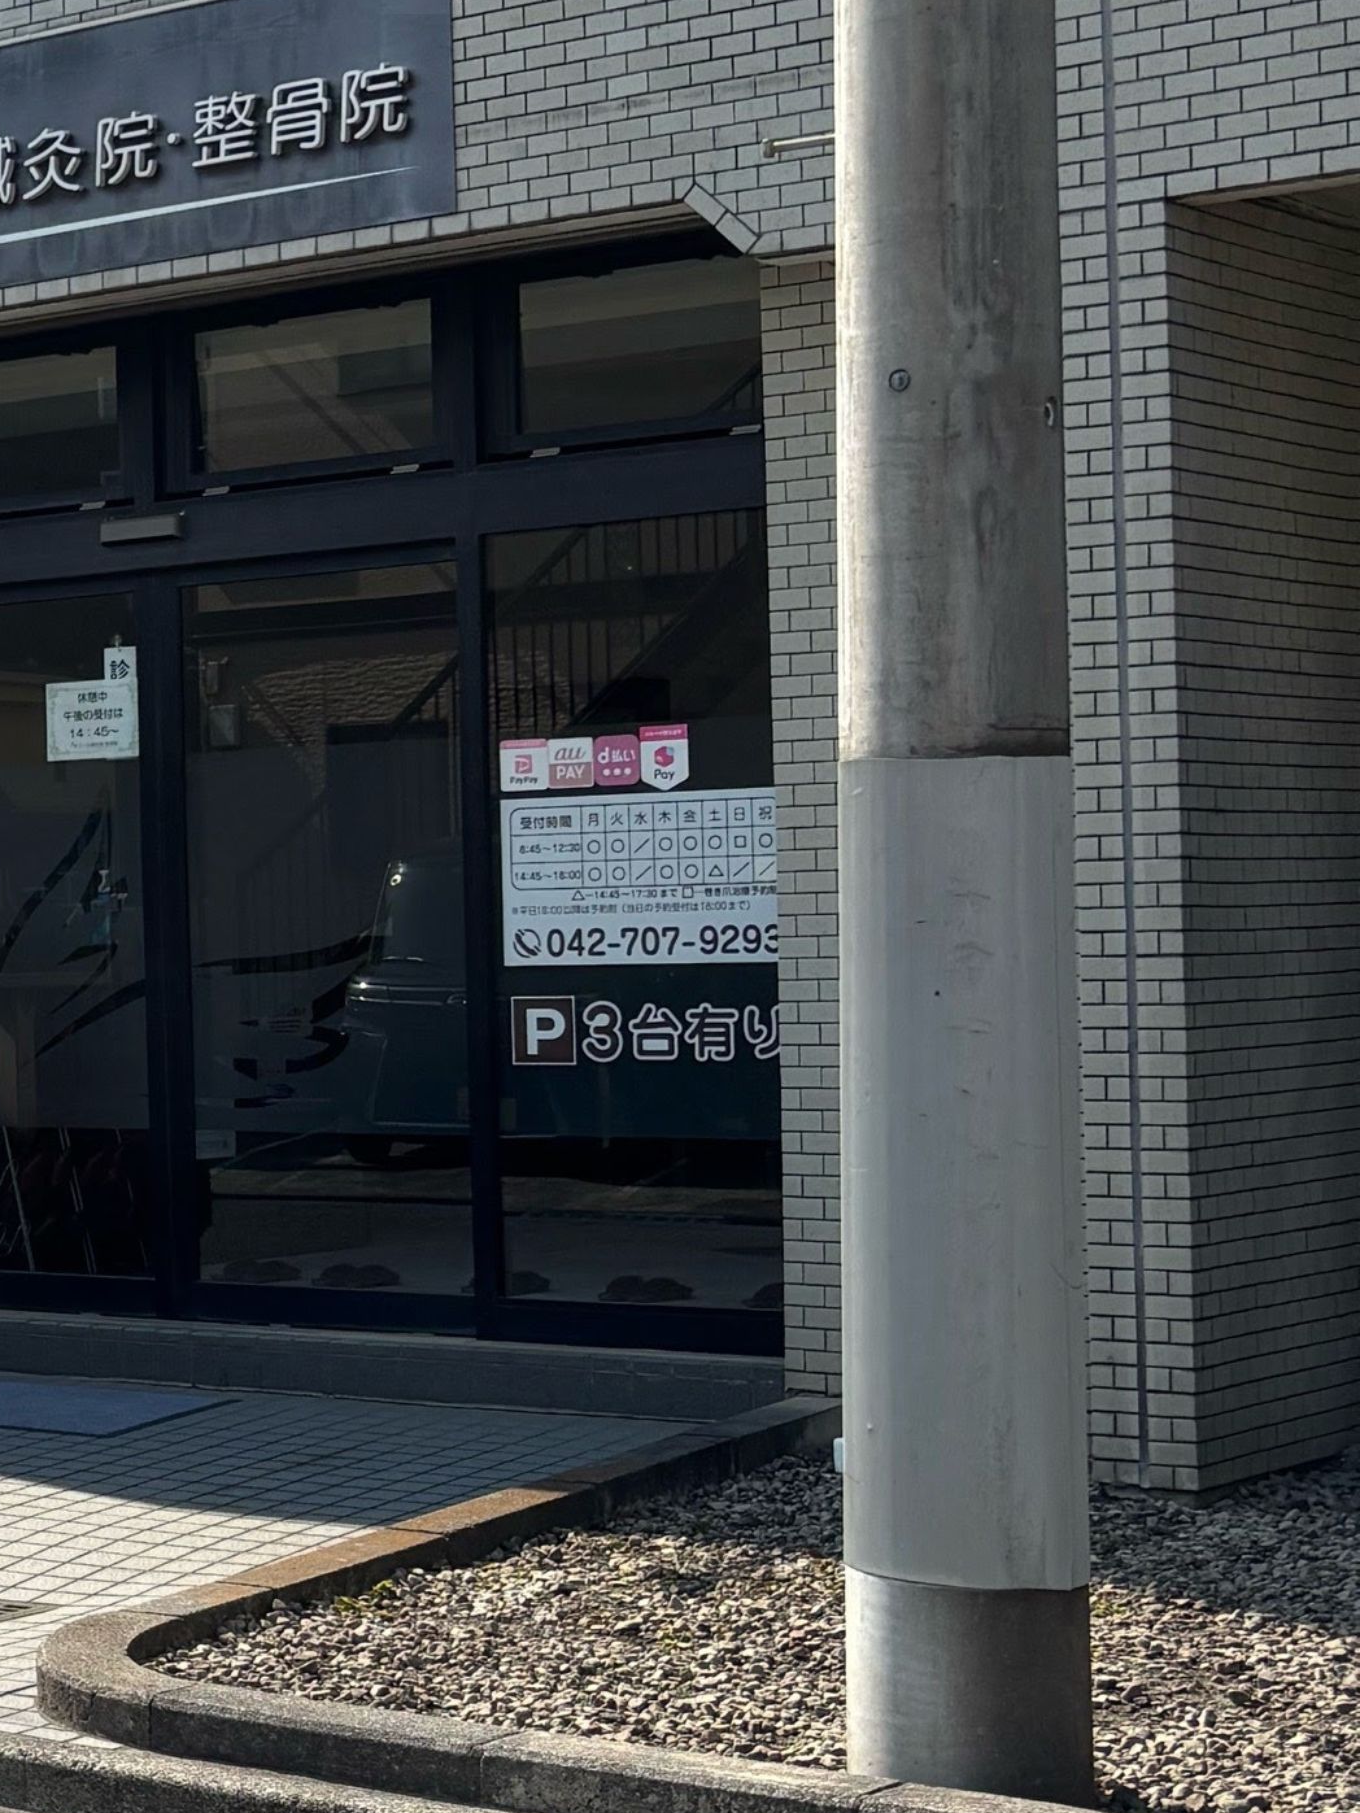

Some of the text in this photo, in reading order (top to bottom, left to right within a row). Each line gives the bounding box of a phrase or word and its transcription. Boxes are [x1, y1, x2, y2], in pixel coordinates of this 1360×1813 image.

[109, 658, 130, 680] 診
[554, 747, 587, 780] au PAY
[597, 746, 637, 764] d払い
[653, 769, 676, 781] Pay
[519, 805, 773, 830] 受付時間 月 火 水 木 金 土 日 祝
[546, 923, 778, 959] 042-707-9293
[525, 1000, 780, 1063] P 3台有り
